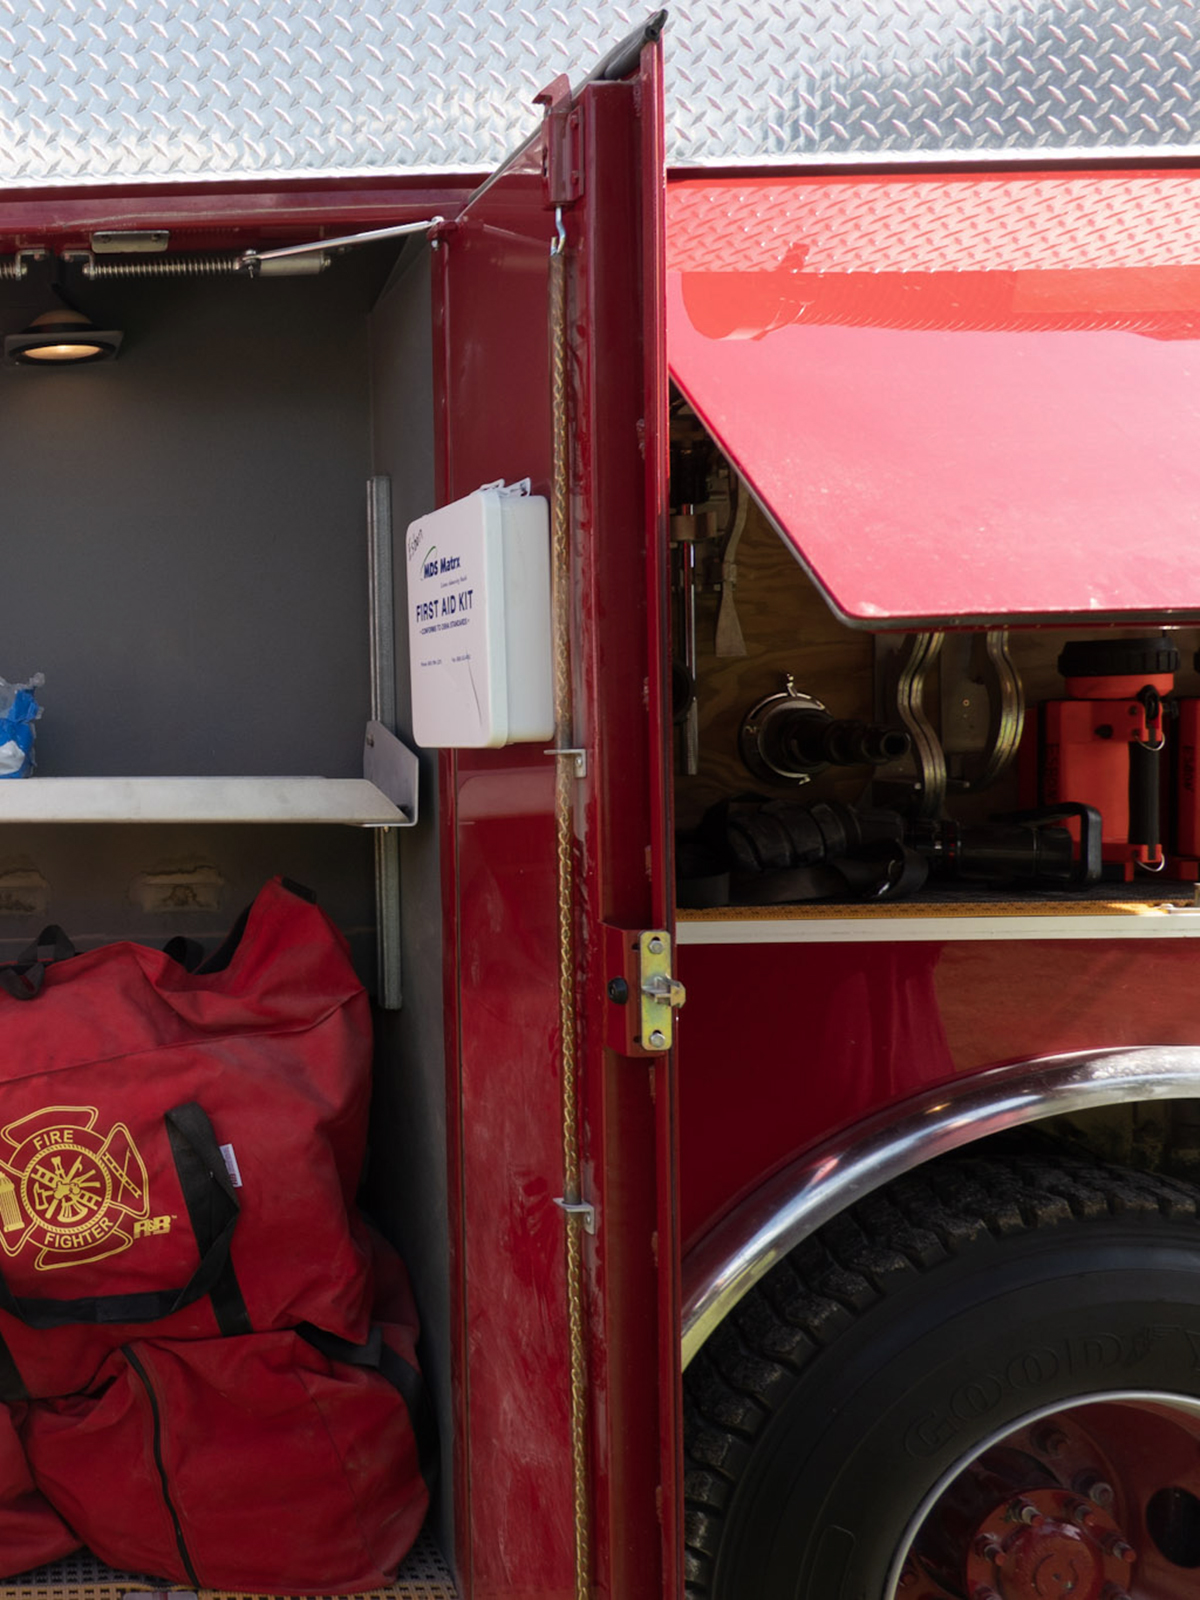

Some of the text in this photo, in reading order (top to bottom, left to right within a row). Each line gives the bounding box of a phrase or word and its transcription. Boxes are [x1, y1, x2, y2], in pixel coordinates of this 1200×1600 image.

[424, 556, 461, 579] MDS Matrx
[416, 589, 473, 623] FIRST AID KIT
[33, 1130, 74, 1150] FIRE
[44, 1216, 113, 1248] FIGHTER
